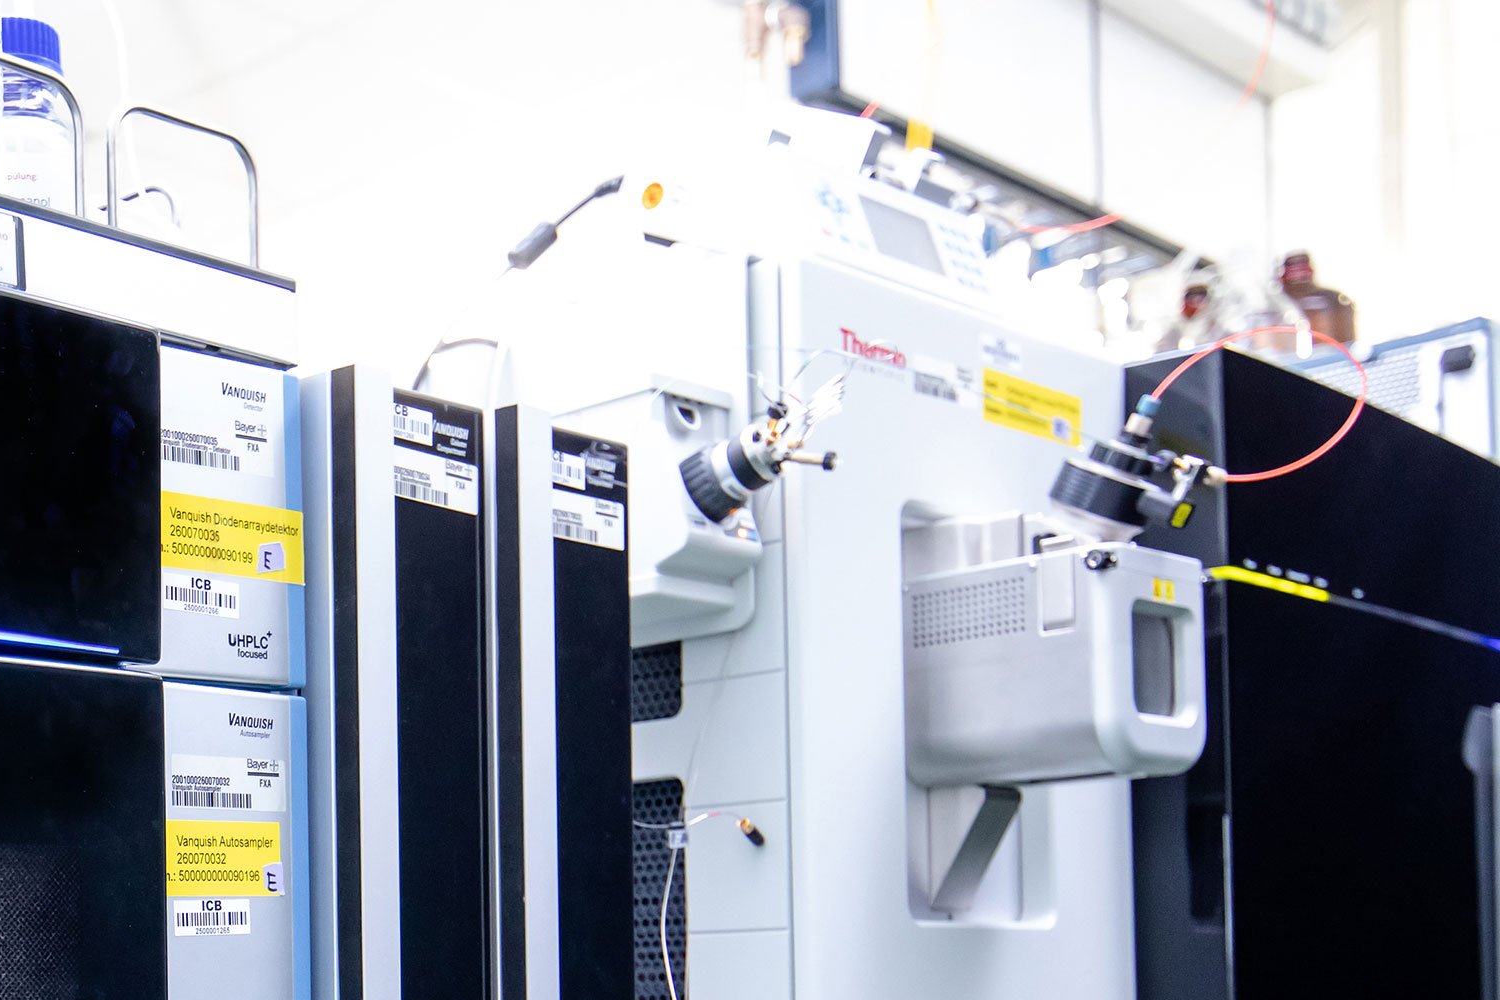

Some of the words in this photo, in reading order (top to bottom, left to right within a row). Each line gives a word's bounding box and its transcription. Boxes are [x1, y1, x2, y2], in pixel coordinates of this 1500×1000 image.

[222, 382, 266, 403] VANQUISH
[235, 420, 256, 433] Bayer
[247, 442, 260, 452] FXA
[169, 507, 212, 524] Vanquish
[214, 513, 299, 536] Diodenarraydetektor
[170, 524, 220, 542] 260070035
[264, 551, 272, 570] E
[191, 577, 211, 590] ICB
[237, 648, 268, 660] focused
[229, 712, 274, 730] VANQUISH
[240, 729, 271, 739] Autosampler
[246, 758, 269, 770] Bayer
[259, 779, 272, 788] FXA
[176, 835, 217, 849] Vanquish
[219, 835, 273, 850] Autosampler
[176, 852, 227, 865] 260070032
[266, 871, 277, 892] E
[202, 900, 222, 911] ICB
